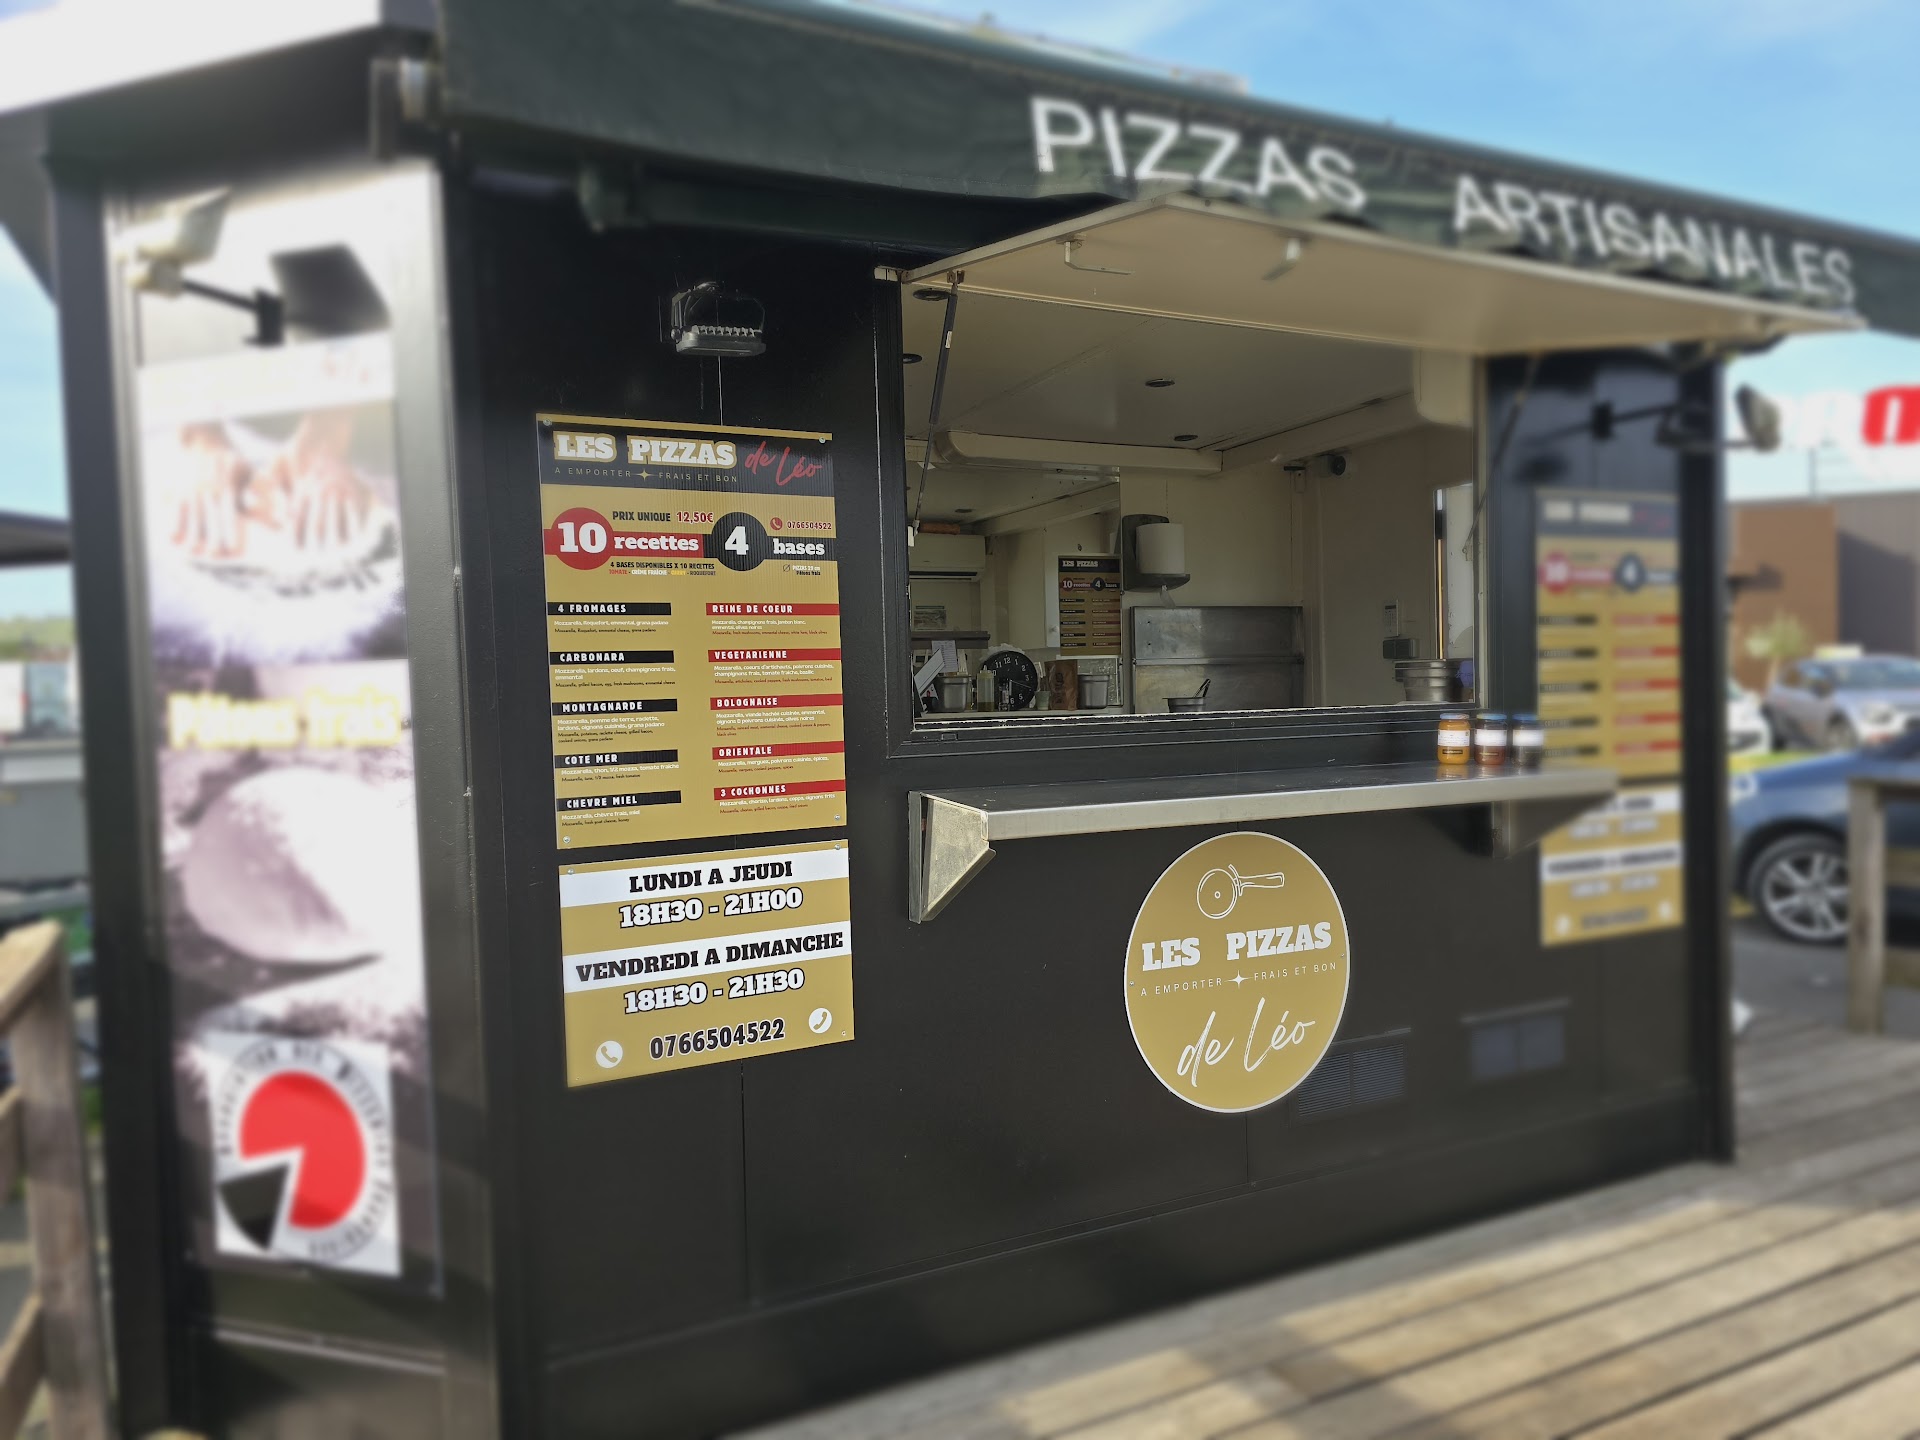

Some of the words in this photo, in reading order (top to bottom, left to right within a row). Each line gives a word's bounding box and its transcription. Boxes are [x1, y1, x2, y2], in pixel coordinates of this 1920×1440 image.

[1031, 97, 1367, 208] PIZZAS
[1453, 172, 1856, 306] ARTISANALES
[555, 432, 616, 461] LES
[629, 437, 736, 467] PIZZAS
[746, 440, 775, 475] de
[776, 446, 822, 486] Léo
[568, 468, 631, 477] EMPORTER
[658, 472, 691, 480] FRAIS
[698, 473, 709, 481] ET
[716, 474, 738, 483] BON
[612, 511, 634, 521] PRIX
[637, 511, 671, 522] UNIQUE
[676, 511, 714, 524] 12,50€
[787, 520, 832, 530] 0766504522
[558, 522, 607, 553] 10
[614, 535, 699, 551] recettes
[724, 526, 749, 556] 4
[772, 538, 826, 556] bases
[557, 604, 564, 612] 4
[570, 604, 627, 612] FROMAGES
[712, 605, 741, 613] REINE
[746, 605, 758, 613] DE
[763, 605, 793, 613] COEUR
[560, 653, 625, 662] CARBONARA
[715, 650, 787, 659] VEGETARIENNE
[563, 702, 643, 712] MONTAGNARDE
[717, 698, 778, 707] BOLOGNAISE
[719, 747, 772, 757] ORIENTALE
[565, 755, 591, 765] COTE
[596, 754, 618, 763] MER
[721, 789, 726, 797] 3
[731, 785, 786, 796] COCHONNES
[566, 797, 607, 809] CHEVRE
[613, 796, 638, 805] MIEL
[629, 870, 702, 893] LUNDI
[708, 868, 724, 885] A
[729, 860, 793, 884] JEUDI
[620, 898, 703, 929] 18H30
[709, 904, 720, 914] -
[724, 886, 804, 917] 21H00
[1142, 937, 1201, 972] LES
[1226, 922, 1332, 961] PIZZAS
[576, 951, 699, 982] VENDREDI
[704, 948, 721, 966] A
[726, 932, 844, 963] DIMANCHE
[1140, 987, 1147, 997] A
[1155, 977, 1223, 995] EMPORTER
[1253, 968, 1289, 981] FRAIS
[1295, 966, 1307, 976] ET
[1313, 962, 1337, 973] BON
[624, 982, 708, 1015] 18H30
[712, 987, 724, 997] -
[728, 968, 805, 999] 21H30
[650, 1018, 785, 1060] 0766504522
[1177, 1010, 1235, 1088] de
[1244, 997, 1316, 1072] Léo
